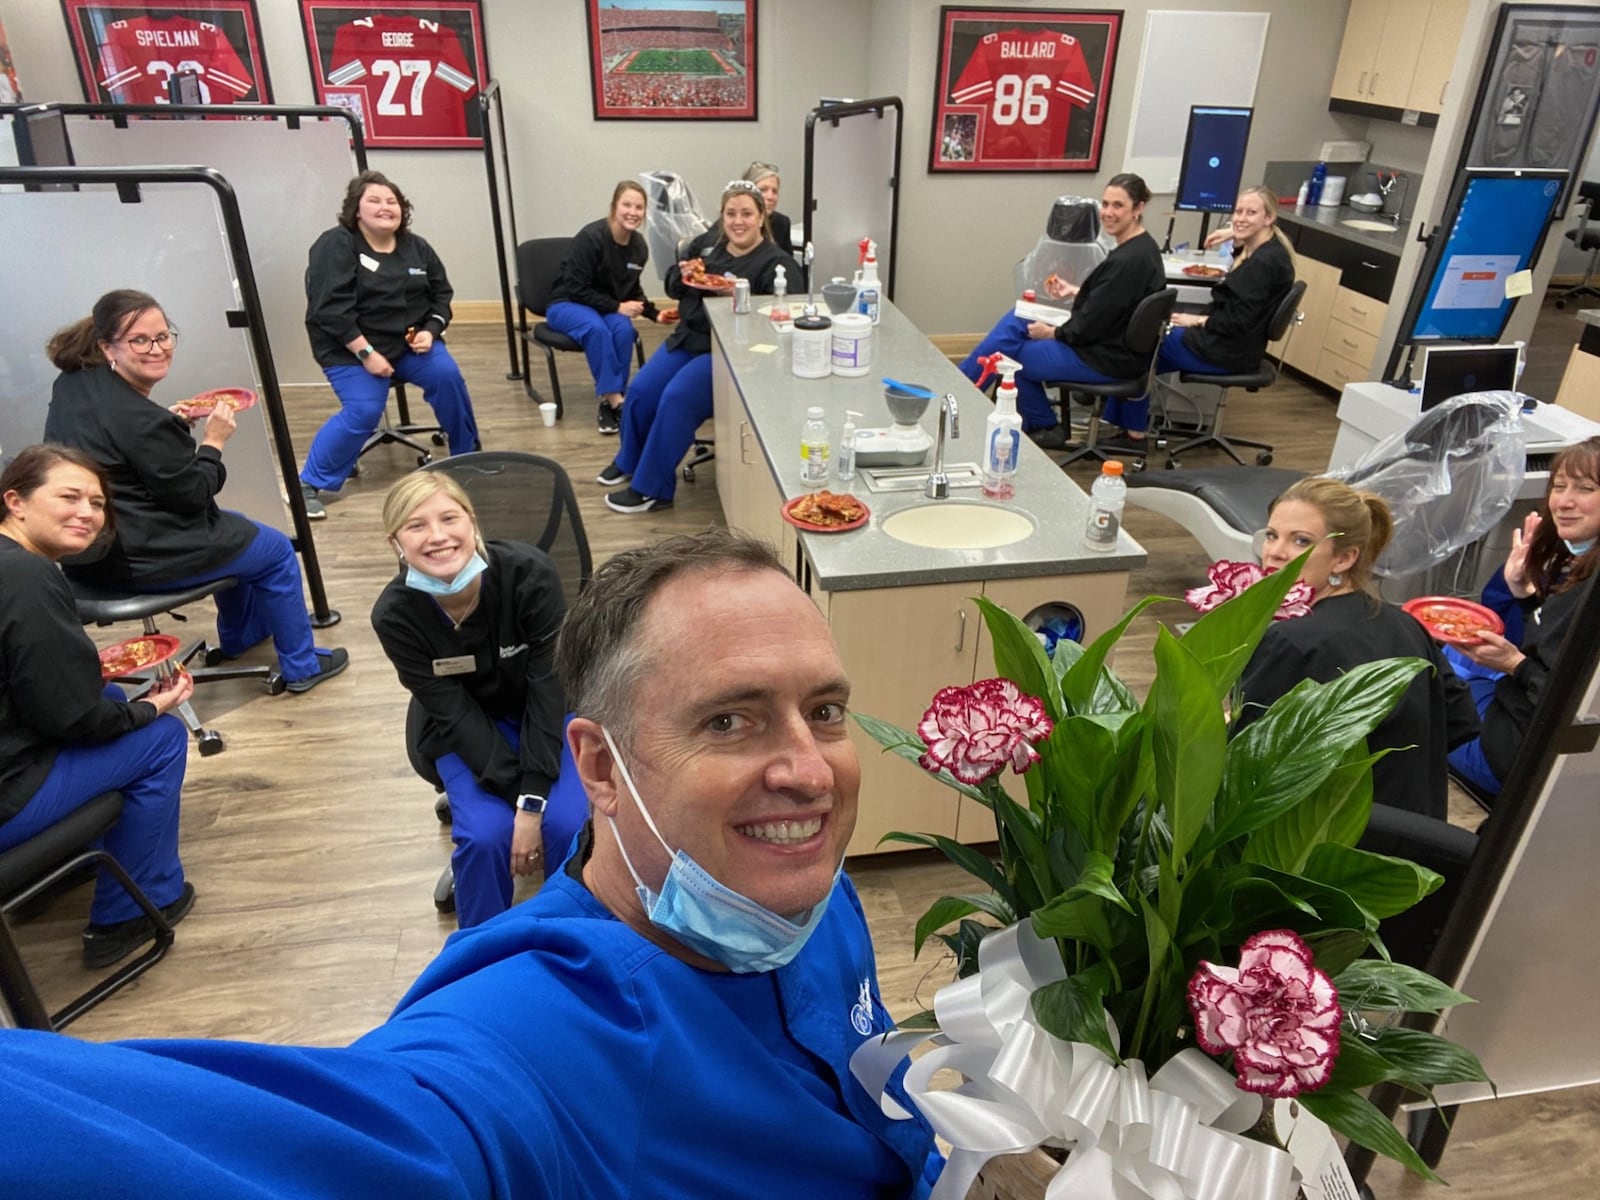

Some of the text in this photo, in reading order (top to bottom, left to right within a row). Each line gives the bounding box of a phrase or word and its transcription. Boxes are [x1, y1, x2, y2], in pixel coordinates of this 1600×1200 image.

[419, 18, 439, 34] 2
[135, 29, 200, 47] SPIELMAN
[381, 32, 415, 47] GEORGE
[1060, 33, 1076, 46] 8
[1000, 41, 1057, 59] BALLARD
[371, 59, 432, 116] 27
[992, 74, 1052, 125] 86
[1095, 513, 1110, 528] G
